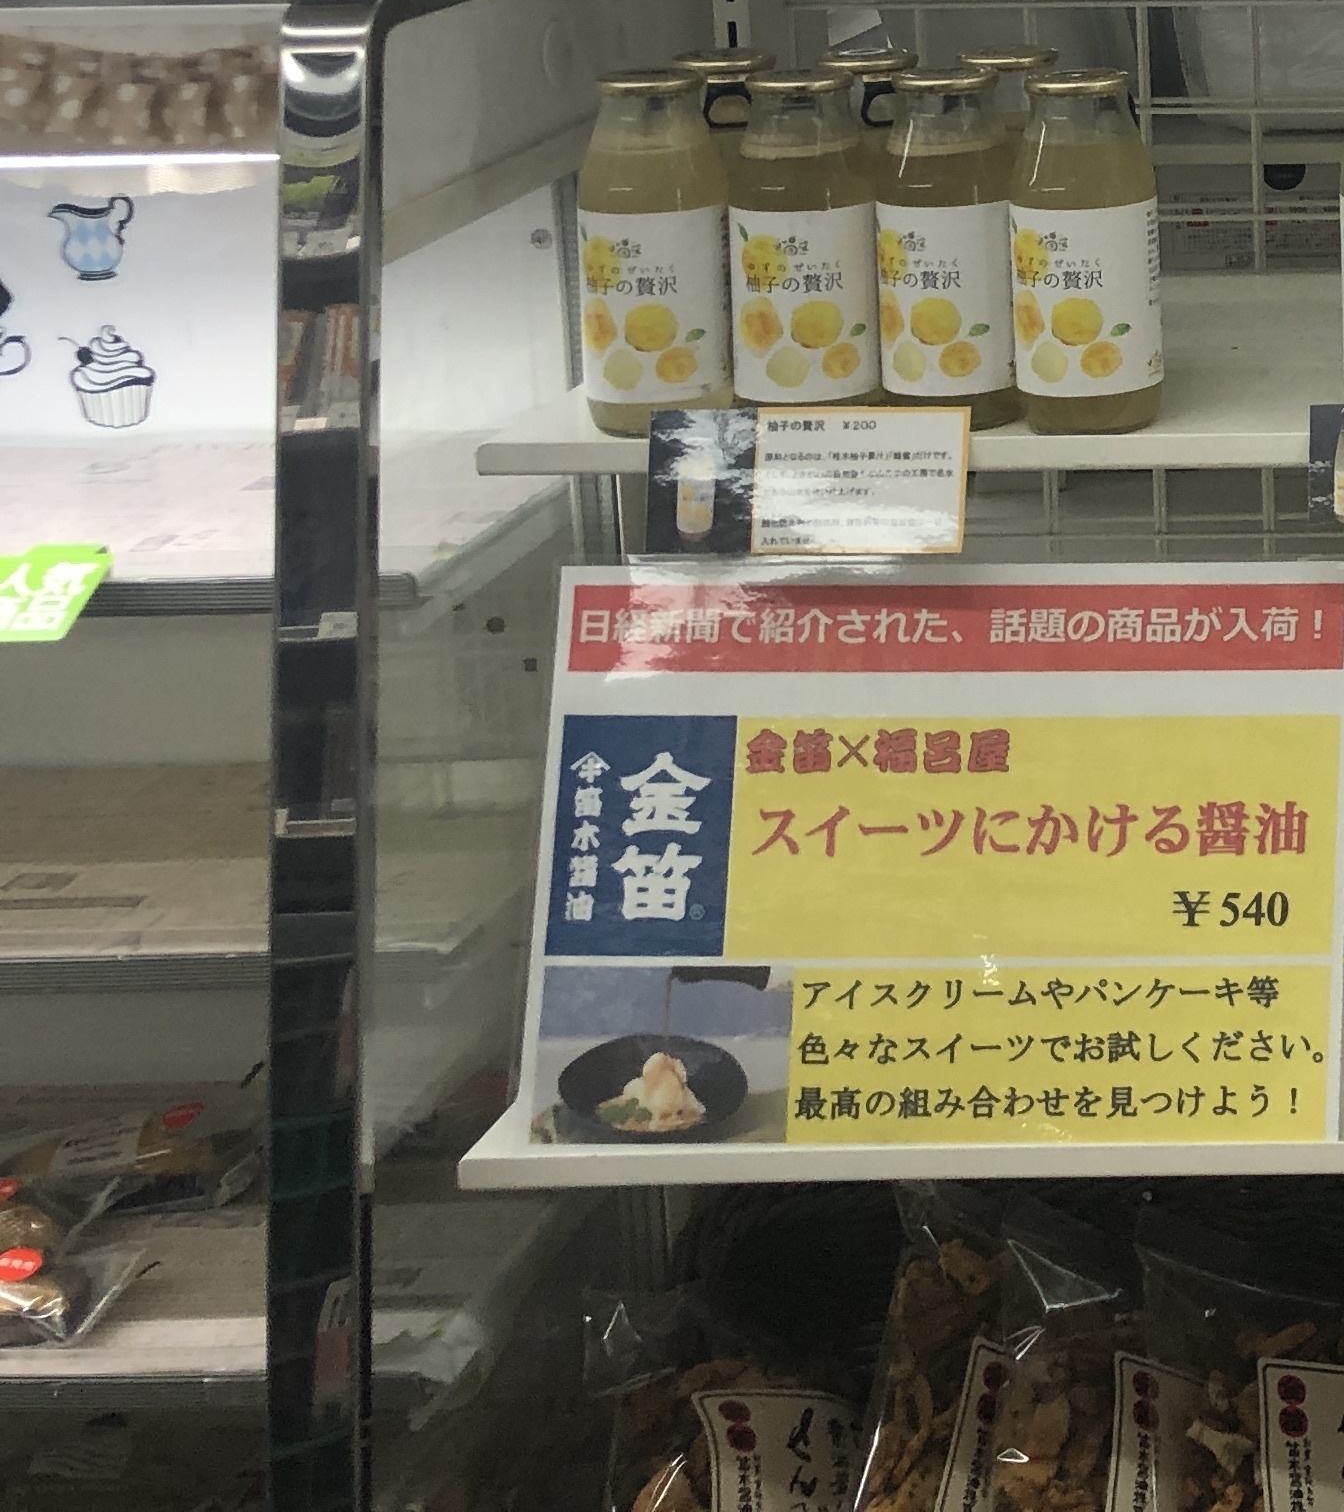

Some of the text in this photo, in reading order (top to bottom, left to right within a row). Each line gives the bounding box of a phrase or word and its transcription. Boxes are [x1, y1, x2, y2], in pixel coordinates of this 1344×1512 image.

[746, 271, 843, 294] 柚子の贅沢
[1017, 269, 1103, 289] 柚子の贅沢
[766, 419, 877, 432] 柚子の贅沢 ¥200
[578, 605, 1325, 645] 日経新聞で紹介された、話題の商品が入荷！
[744, 729, 1011, 774] 金笛×福呂屋
[612, 750, 712, 923] 金笛
[752, 806, 1308, 859] スイーツにかける醤油
[801, 977, 1280, 1011] アイスクリームやパンケーキ等
[797, 1031, 1325, 1066] 色々なスイーツでお試しください。
[793, 1085, 1300, 1121] 最高の組み合わせを見つけよう！
